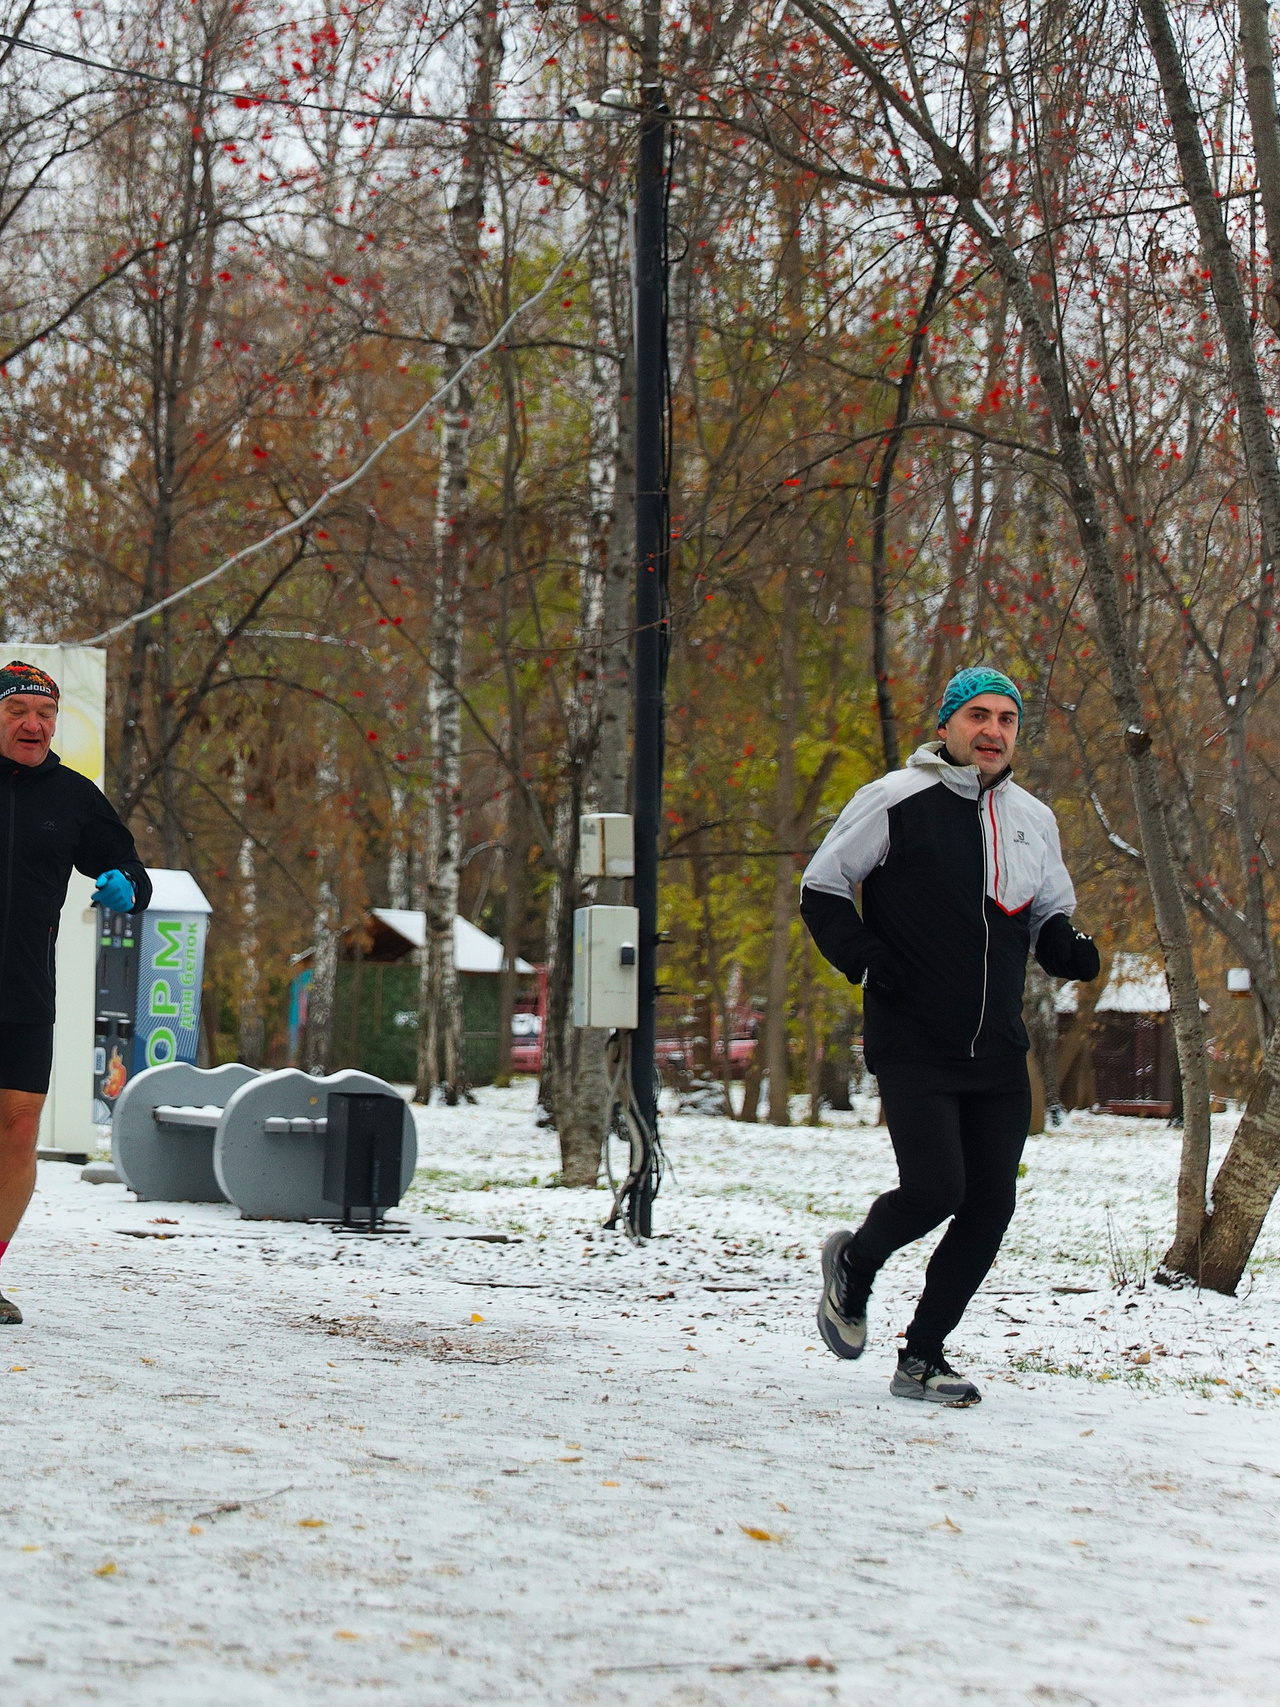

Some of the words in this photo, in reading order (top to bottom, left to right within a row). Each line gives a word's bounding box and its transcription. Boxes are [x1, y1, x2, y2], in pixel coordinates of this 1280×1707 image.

[19, 684, 52, 694] СПОРТ
[179, 922, 199, 986] белок
[145, 919, 184, 1068] ОРМ
[179, 989, 196, 1031] для
